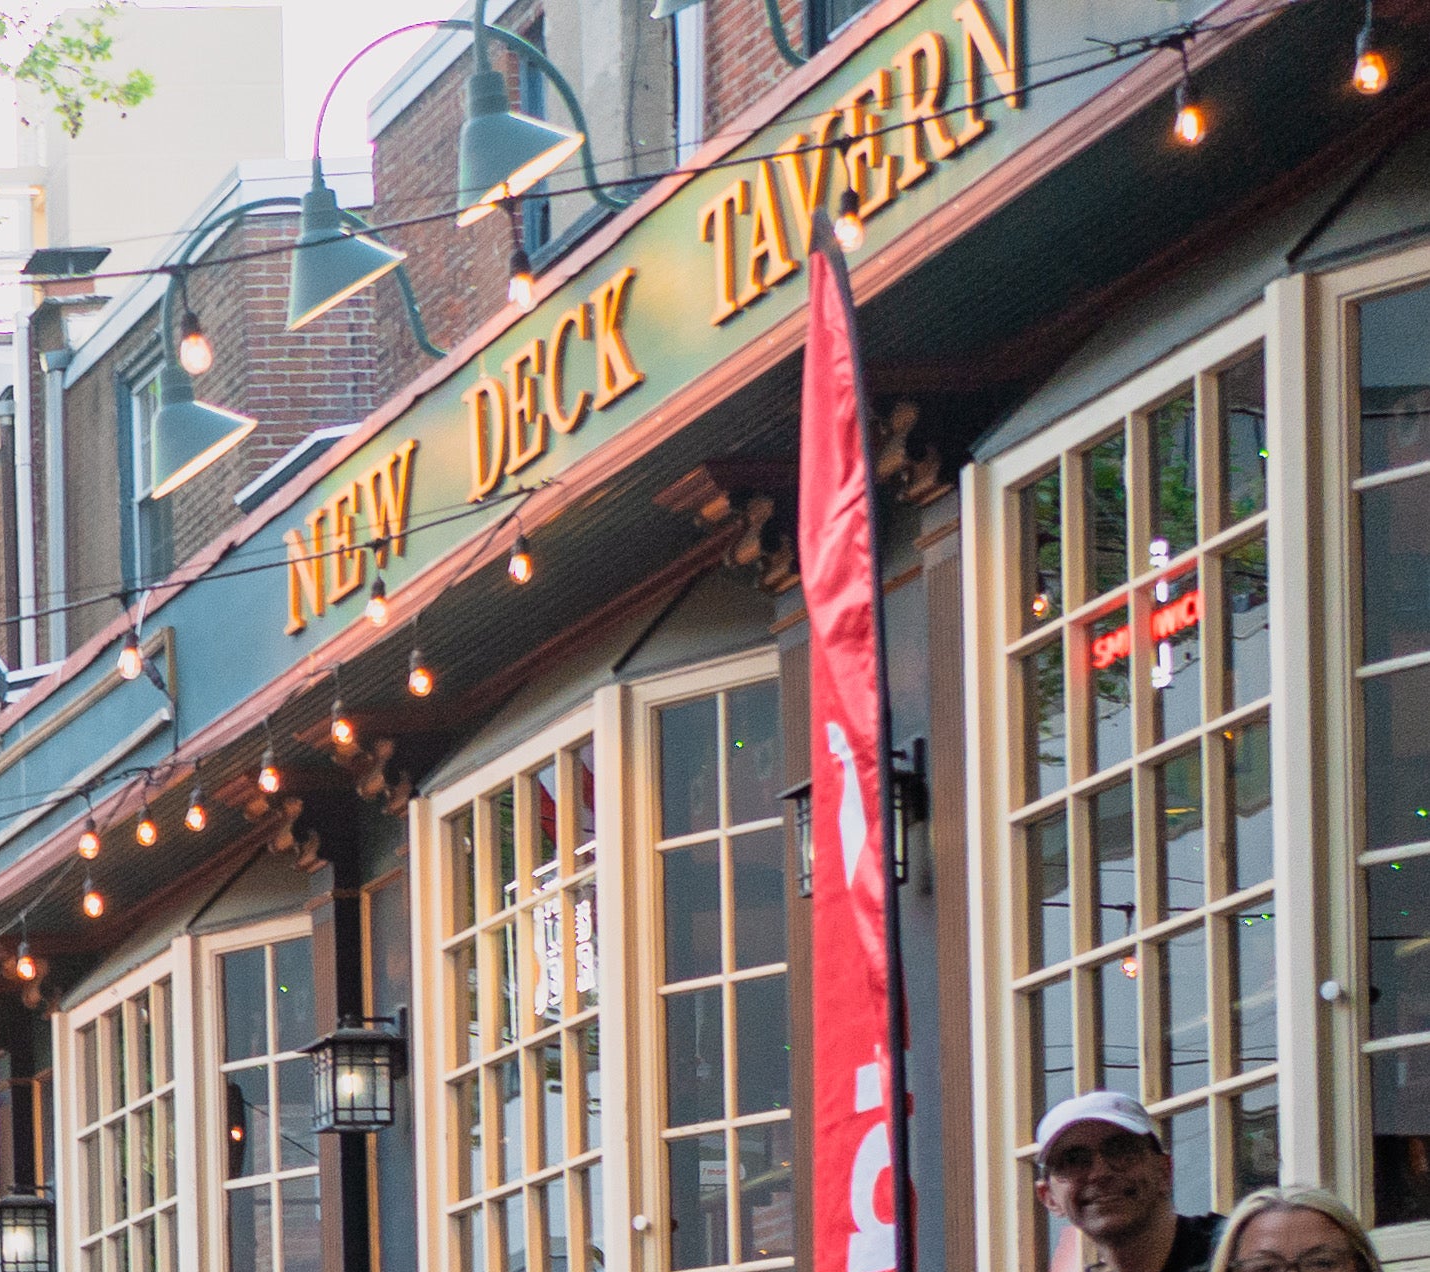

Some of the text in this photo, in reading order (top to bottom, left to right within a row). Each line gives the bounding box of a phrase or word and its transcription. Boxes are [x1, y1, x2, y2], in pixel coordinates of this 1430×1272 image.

[283, 0, 1024, 635] NEW DECK TAVERN
